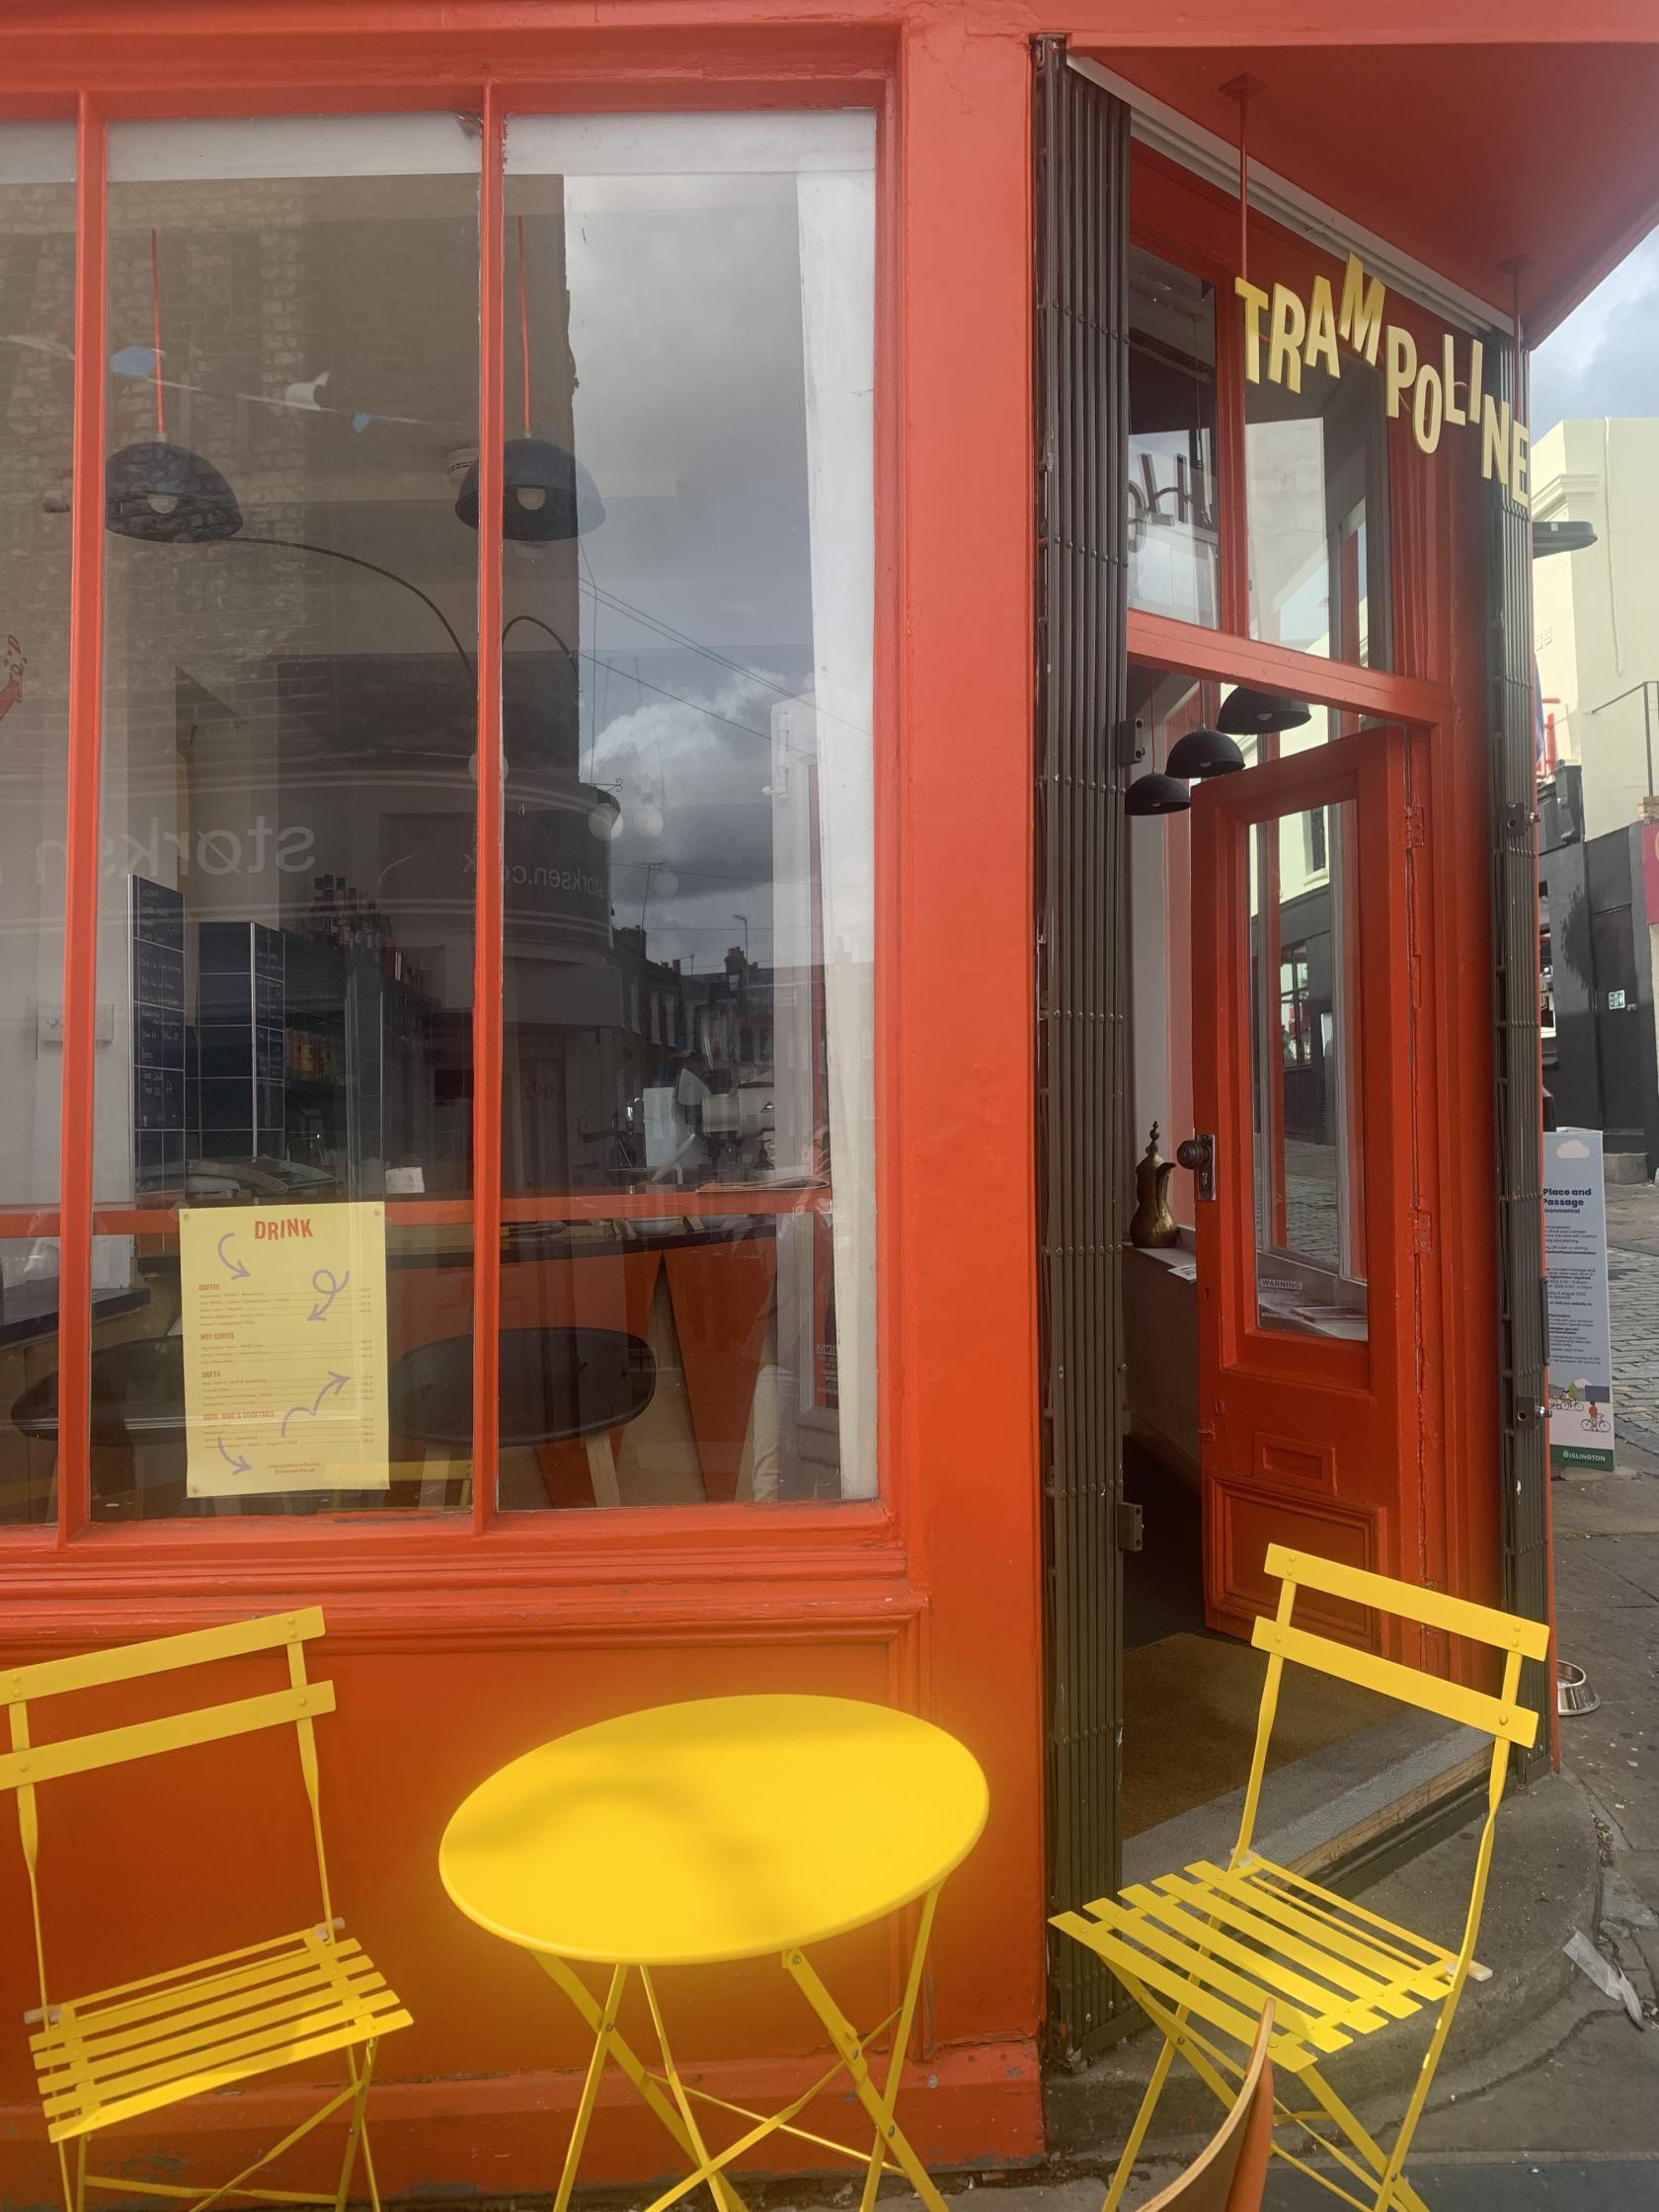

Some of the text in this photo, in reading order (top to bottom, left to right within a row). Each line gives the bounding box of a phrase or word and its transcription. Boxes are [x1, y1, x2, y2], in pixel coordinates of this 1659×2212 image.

[1234, 252, 1530, 508] TRAMPOLINE
[254, 1218, 314, 1241] DRINK
[198, 1283, 220, 1292] COFFEE
[1262, 1279, 1301, 1289] WARNING
[213, 1331, 235, 1340] COFFEE
[201, 1370, 221, 1379] SOFTS
[243, 1410, 276, 1419] COCKTAILS
[1569, 1452, 1607, 1462] ISLINGTON
